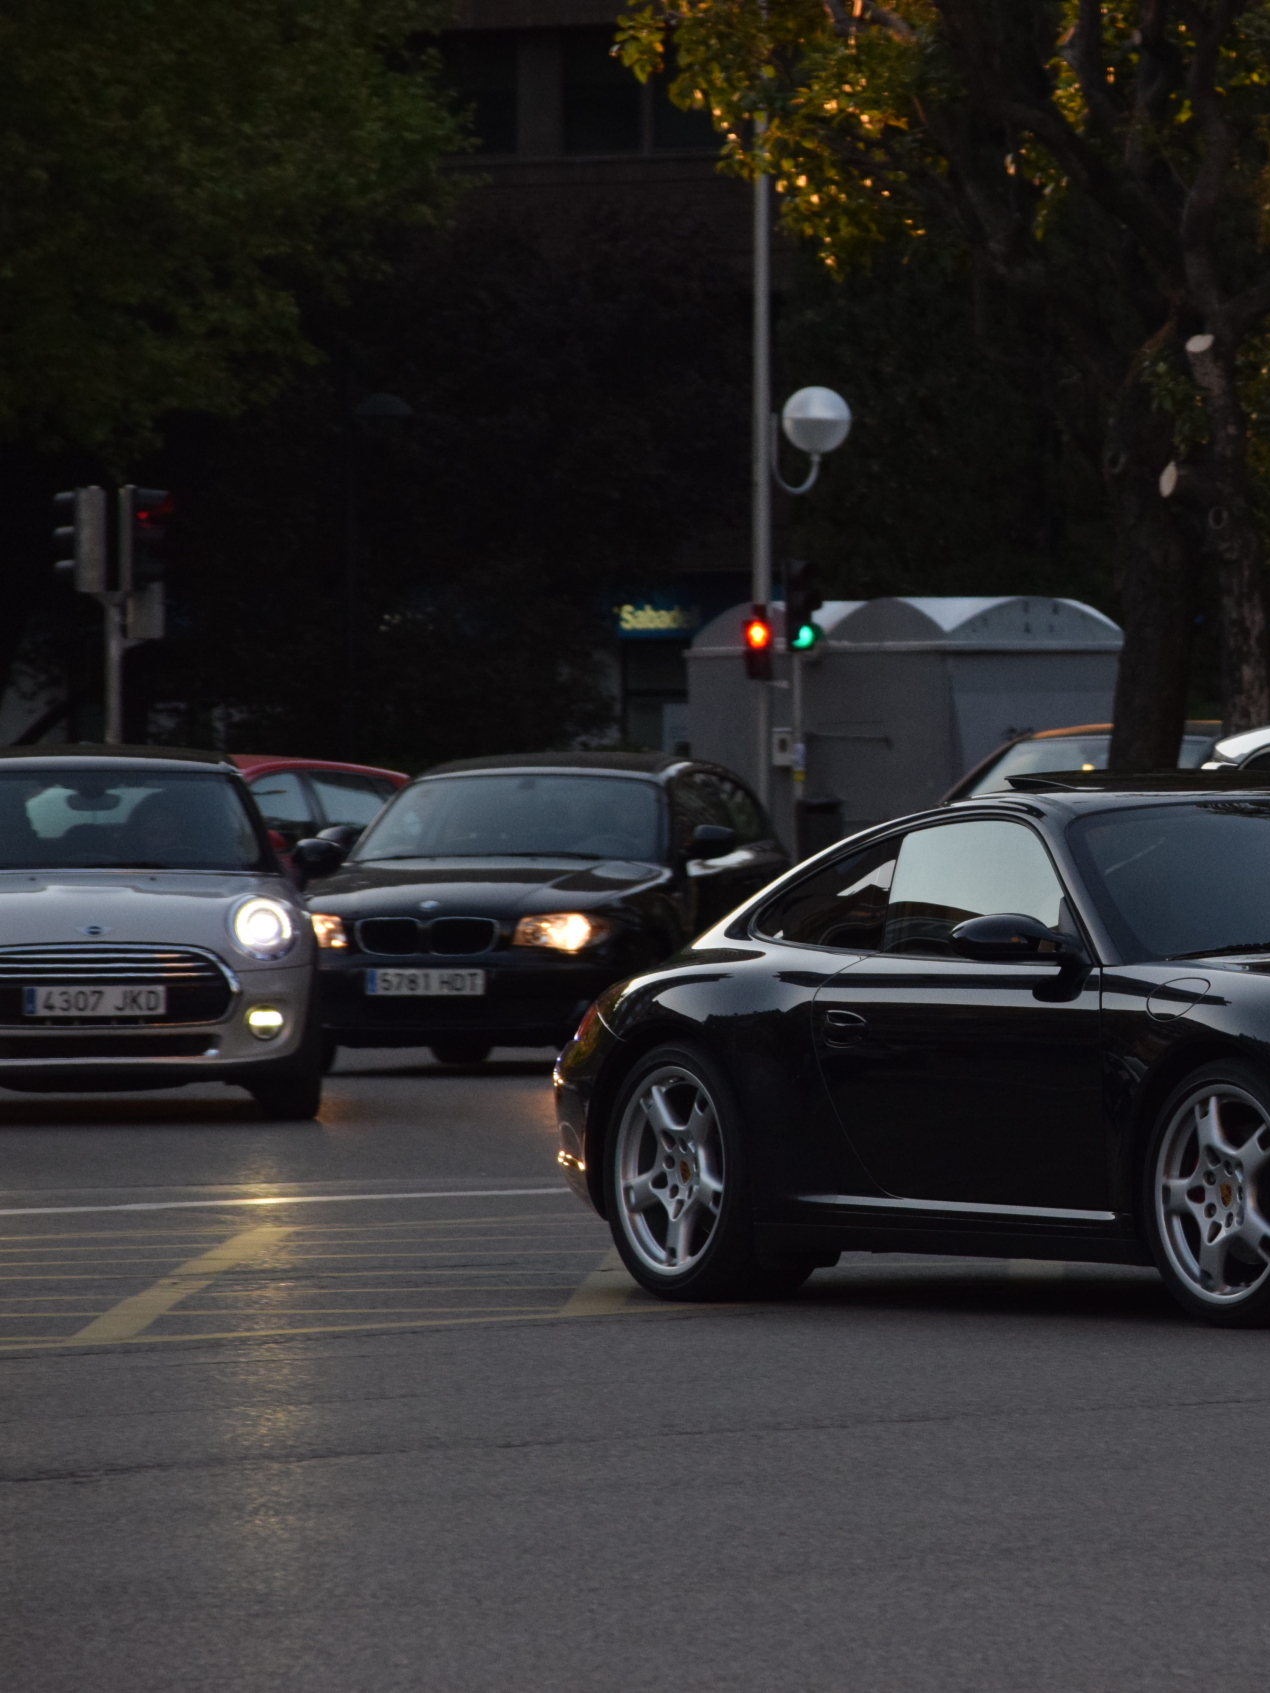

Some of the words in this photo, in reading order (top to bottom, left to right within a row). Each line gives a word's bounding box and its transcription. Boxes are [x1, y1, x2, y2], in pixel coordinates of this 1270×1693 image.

[440, 972, 478, 991] HDT
[43, 990, 103, 1012] 4307
[115, 990, 160, 1011] JKD
